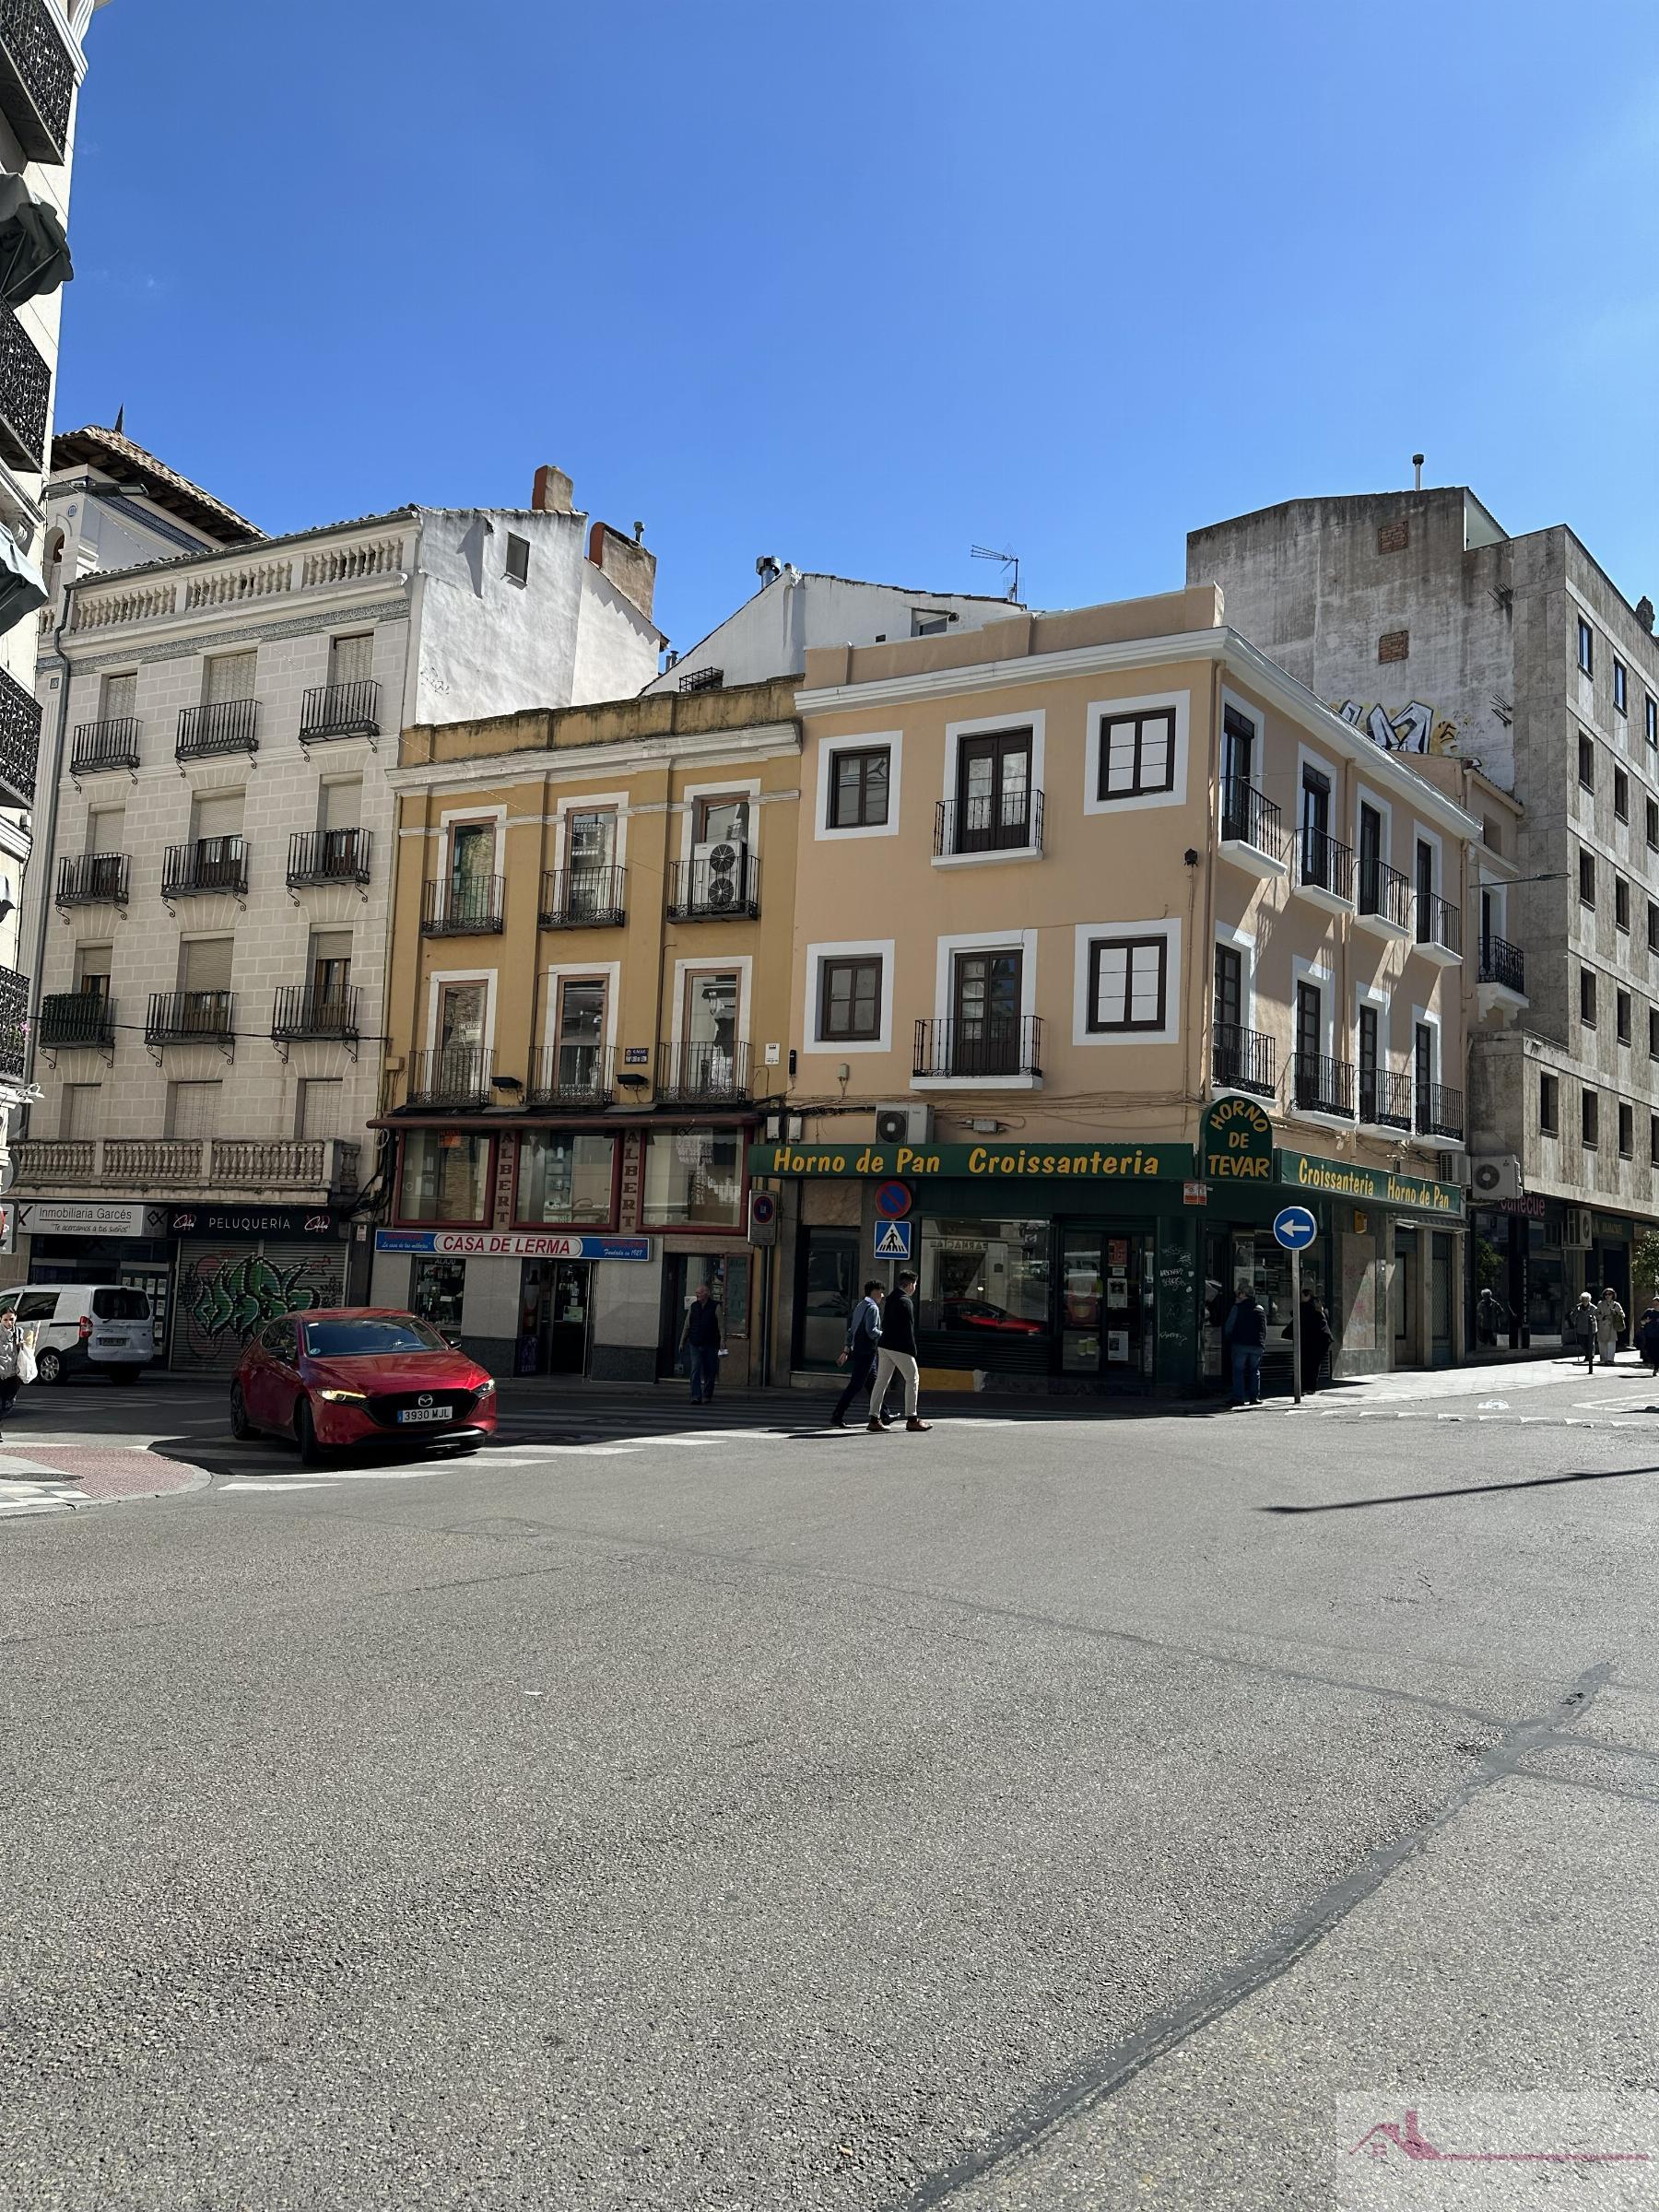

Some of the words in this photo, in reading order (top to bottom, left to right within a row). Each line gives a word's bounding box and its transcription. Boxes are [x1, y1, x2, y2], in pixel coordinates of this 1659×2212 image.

[1209, 1100, 1269, 1133] HORNO
[1229, 1132, 1249, 1148] DE
[773, 1147, 845, 1173] Horno
[855, 1147, 884, 1173] de
[896, 1147, 940, 1173] Pan
[969, 1147, 1159, 1175] Croissanteria
[1207, 1154, 1270, 1178] TEVAR
[496, 1132, 514, 1224] ALBERT
[621, 1131, 640, 1228] ALBERT
[1298, 1157, 1374, 1196] Croissanteria
[1387, 1176, 1417, 1204] Horno
[1419, 1183, 1430, 1206] de
[1433, 1185, 1450, 1209] Pan
[39, 1207, 92, 1219] Inmobiliaria
[97, 1207, 132, 1220] Garcés
[208, 1217, 290, 1230] PELUQUERÍA
[443, 1236, 485, 1252] CASA
[489, 1238, 512, 1253] DE
[515, 1238, 571, 1254] LERMA
[405, 1410, 429, 1421] 3930
[432, 1408, 450, 1419] MJL
